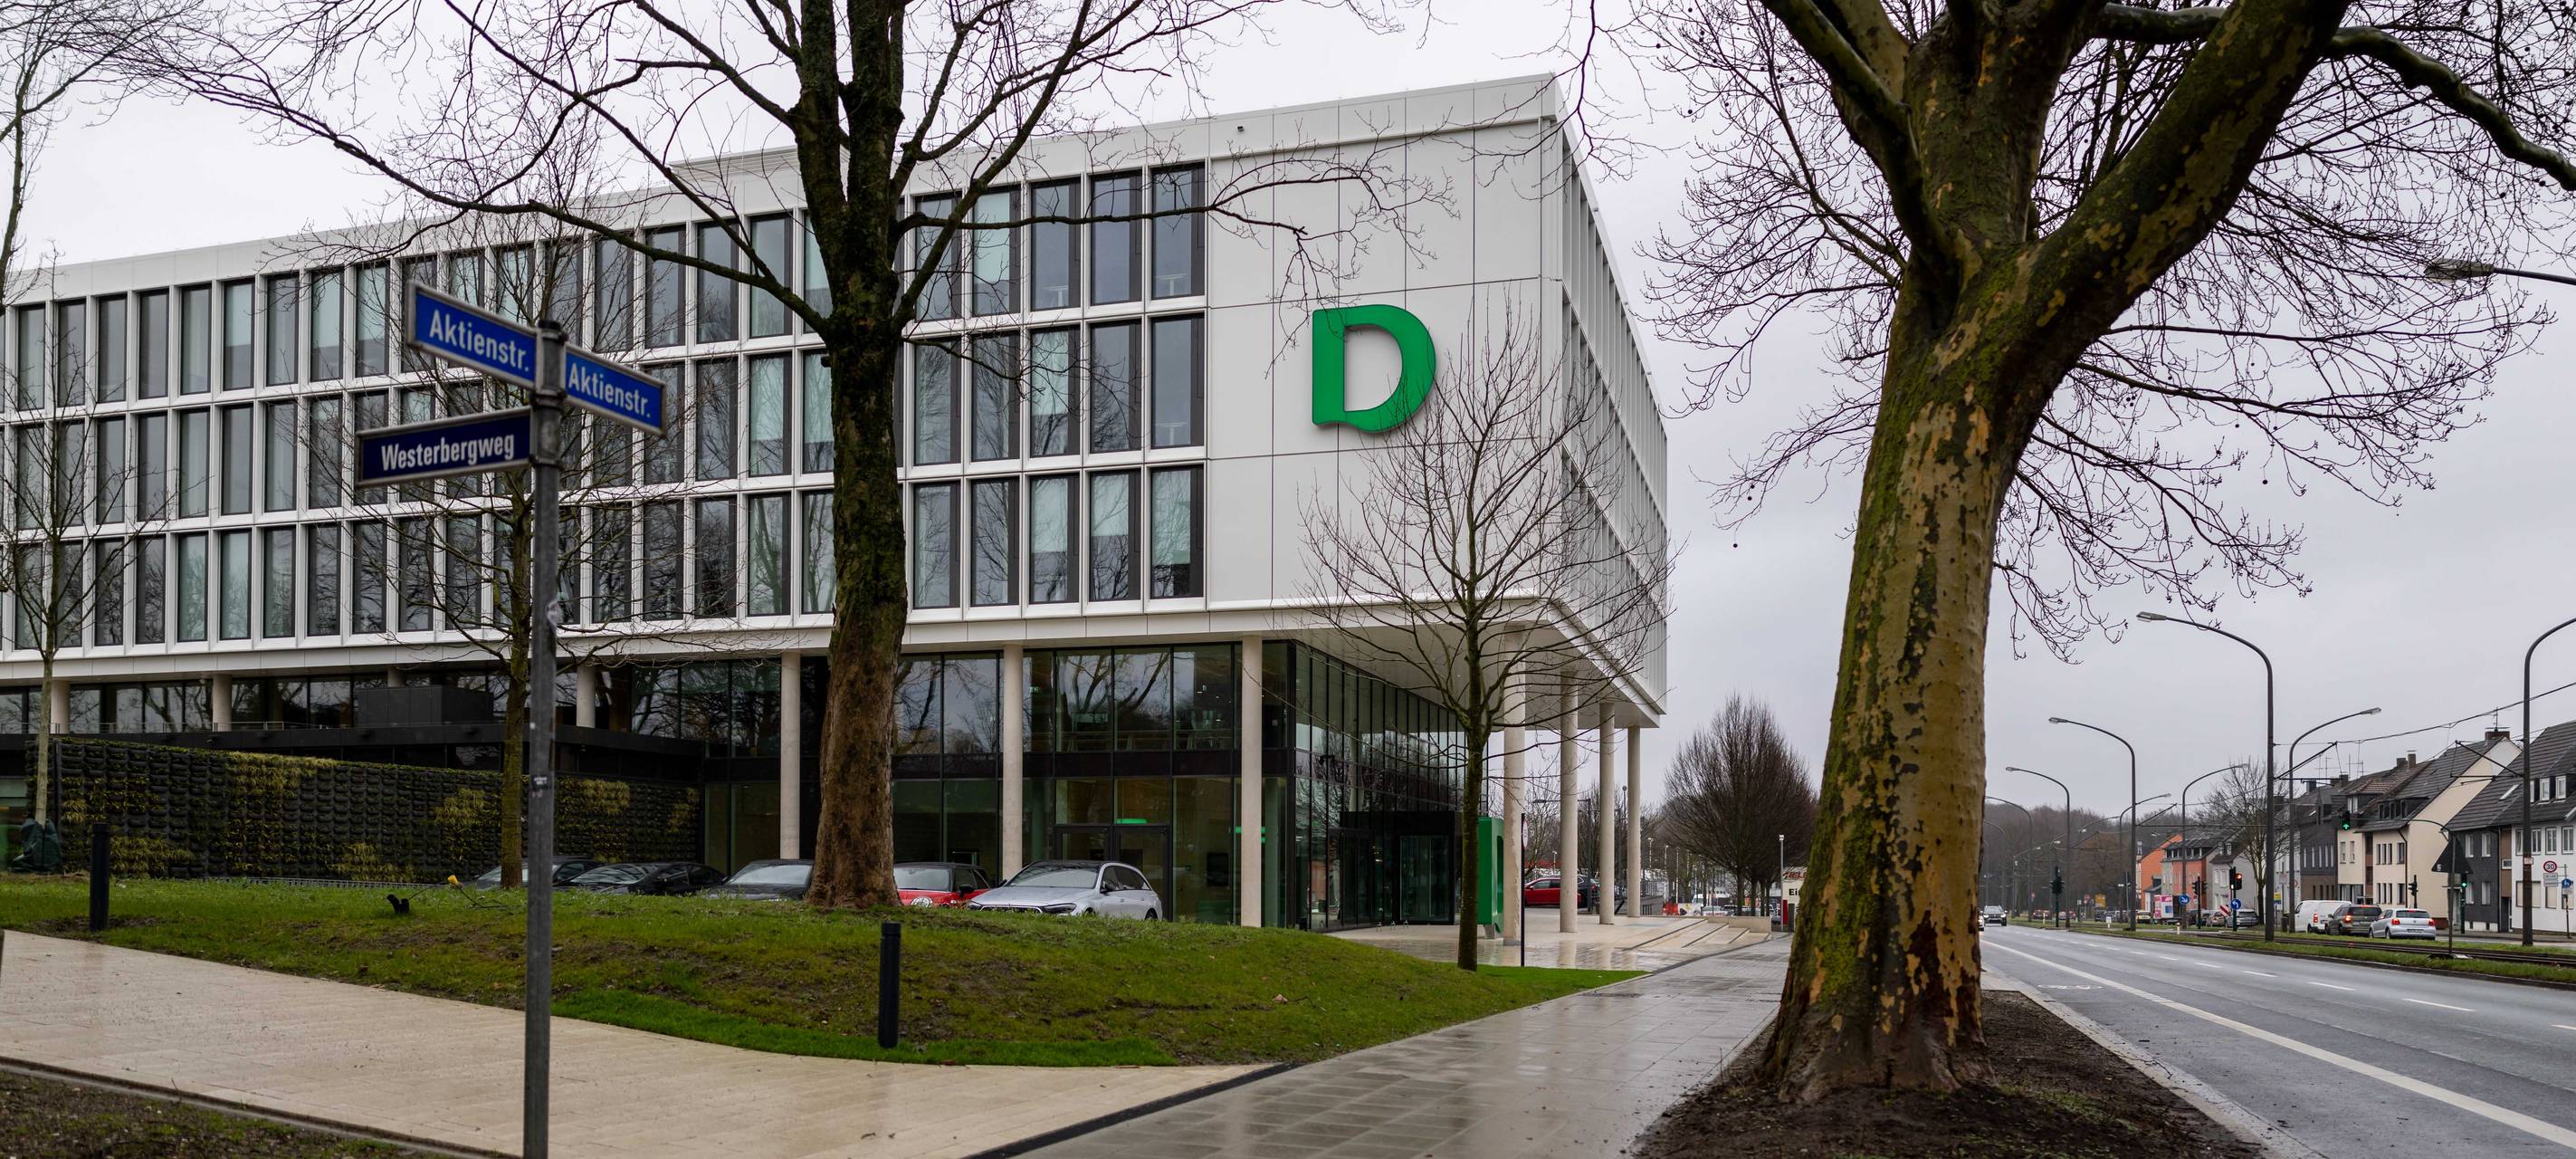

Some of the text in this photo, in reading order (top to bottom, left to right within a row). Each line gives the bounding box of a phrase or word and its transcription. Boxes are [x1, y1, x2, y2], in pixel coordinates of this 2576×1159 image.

[429, 310, 530, 371] Aktienstr.
[1312, 304, 1436, 433] D
[568, 364, 651, 418] Aktienstr.
[381, 435, 514, 471] Westerbergweg
